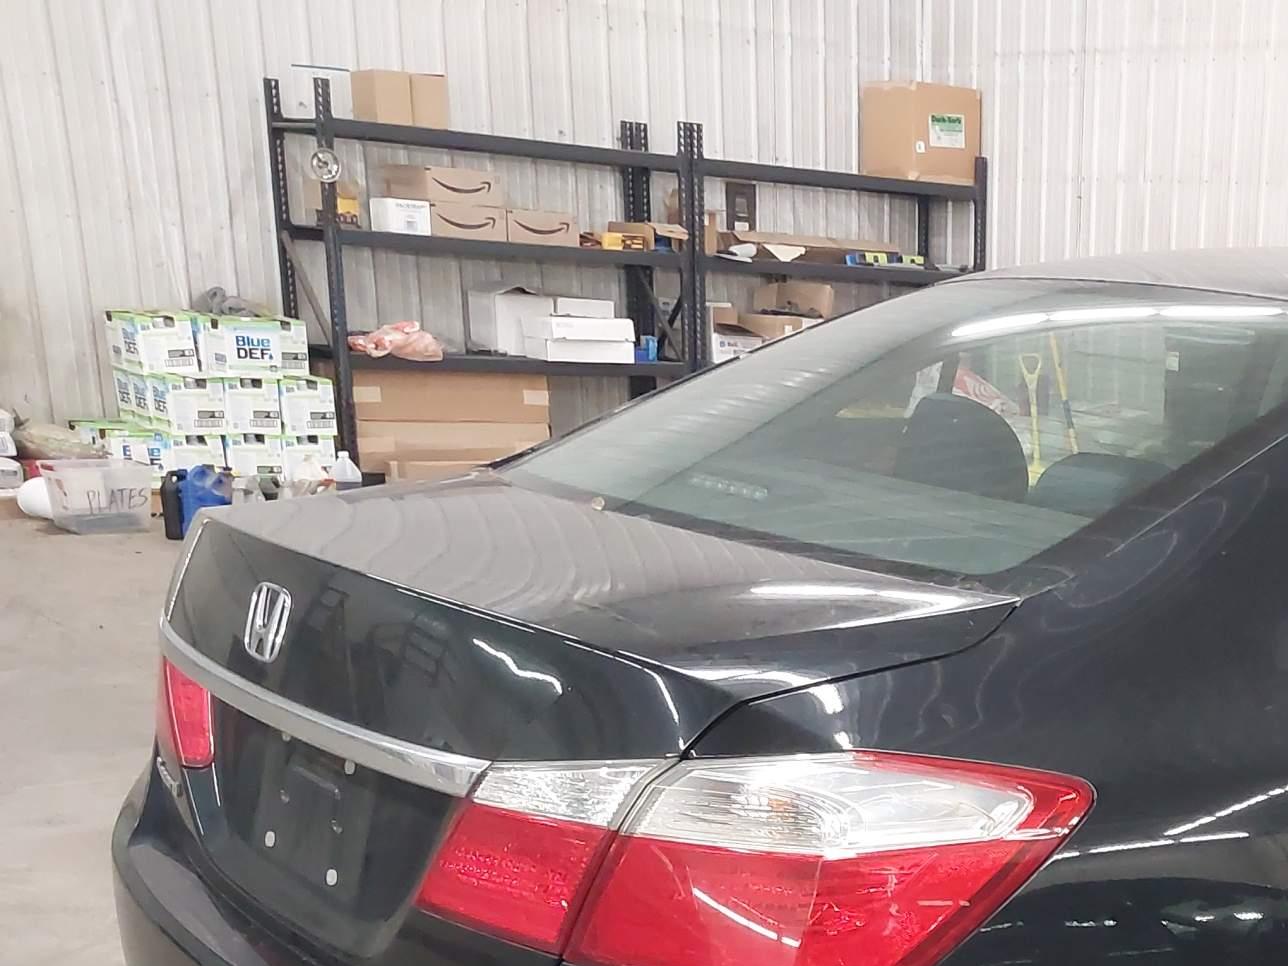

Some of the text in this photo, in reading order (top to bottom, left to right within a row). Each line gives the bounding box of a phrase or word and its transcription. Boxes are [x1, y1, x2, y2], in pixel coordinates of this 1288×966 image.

[235, 335, 271, 347] Blue
[236, 347, 271, 360] DEF
[86, 487, 148, 516] PLATES
